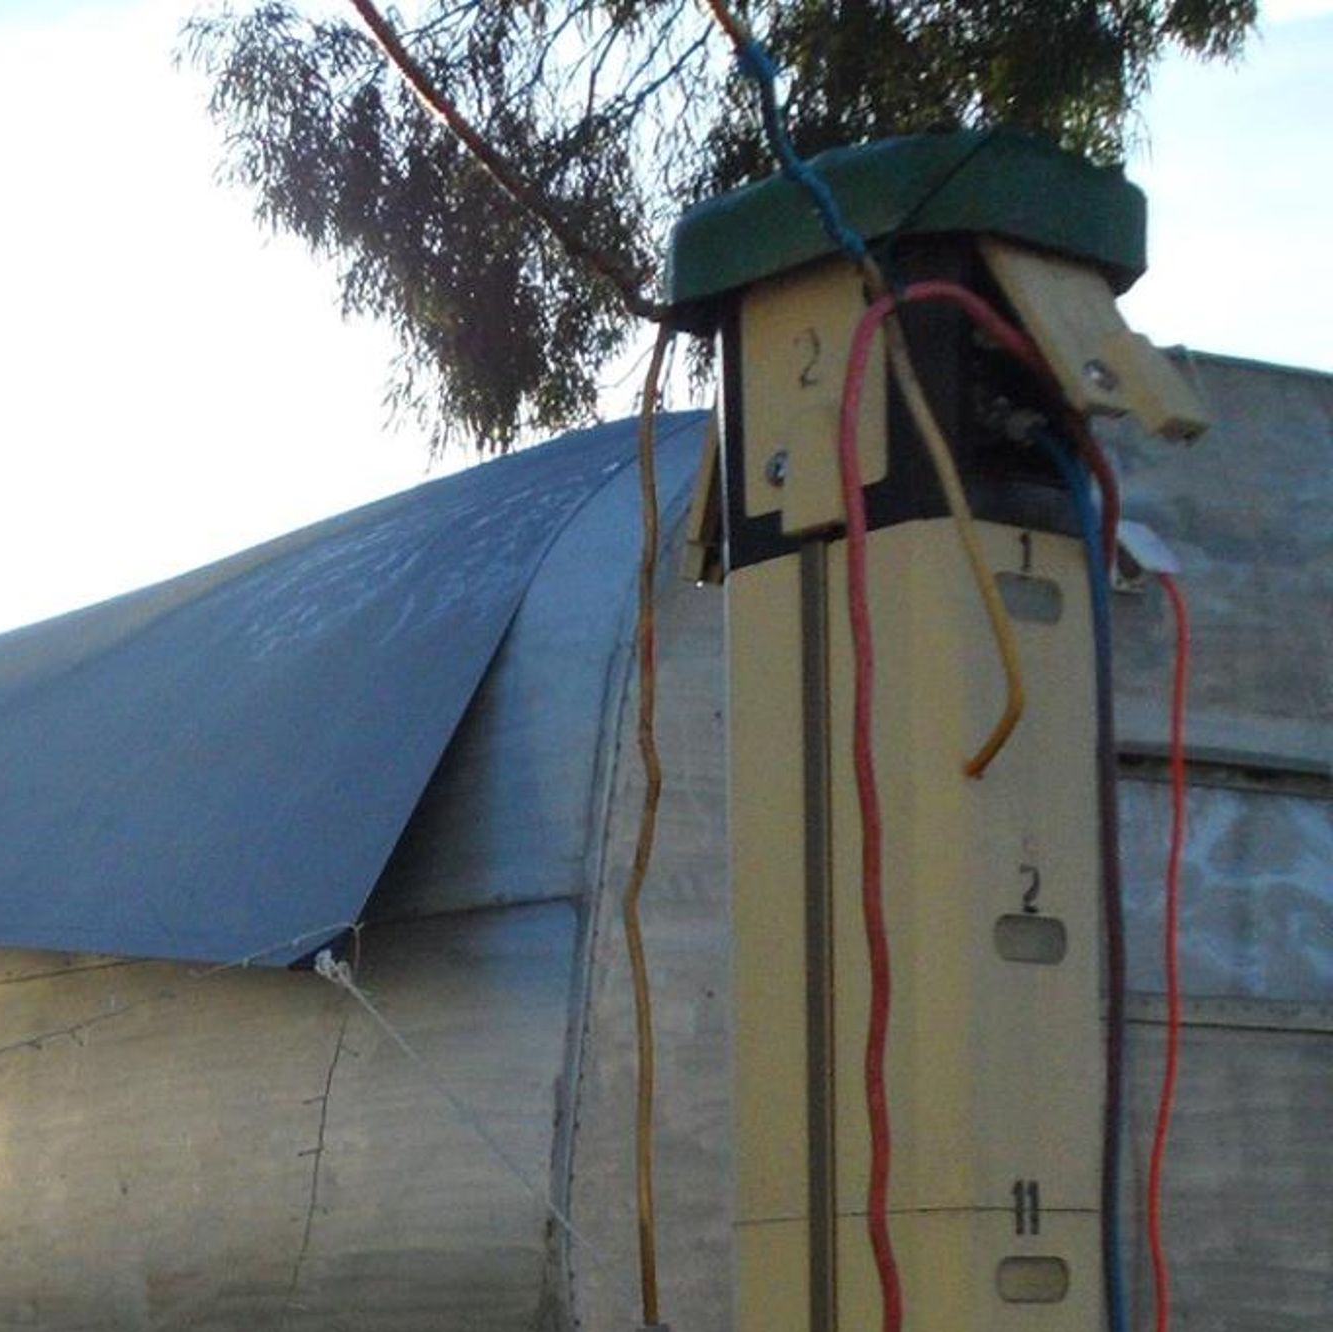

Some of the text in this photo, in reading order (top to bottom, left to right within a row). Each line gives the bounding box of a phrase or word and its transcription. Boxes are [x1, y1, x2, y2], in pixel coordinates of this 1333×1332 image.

[793, 326, 820, 389] 2
[1019, 863, 1040, 913] 2
[1012, 1179, 1040, 1236] 11
